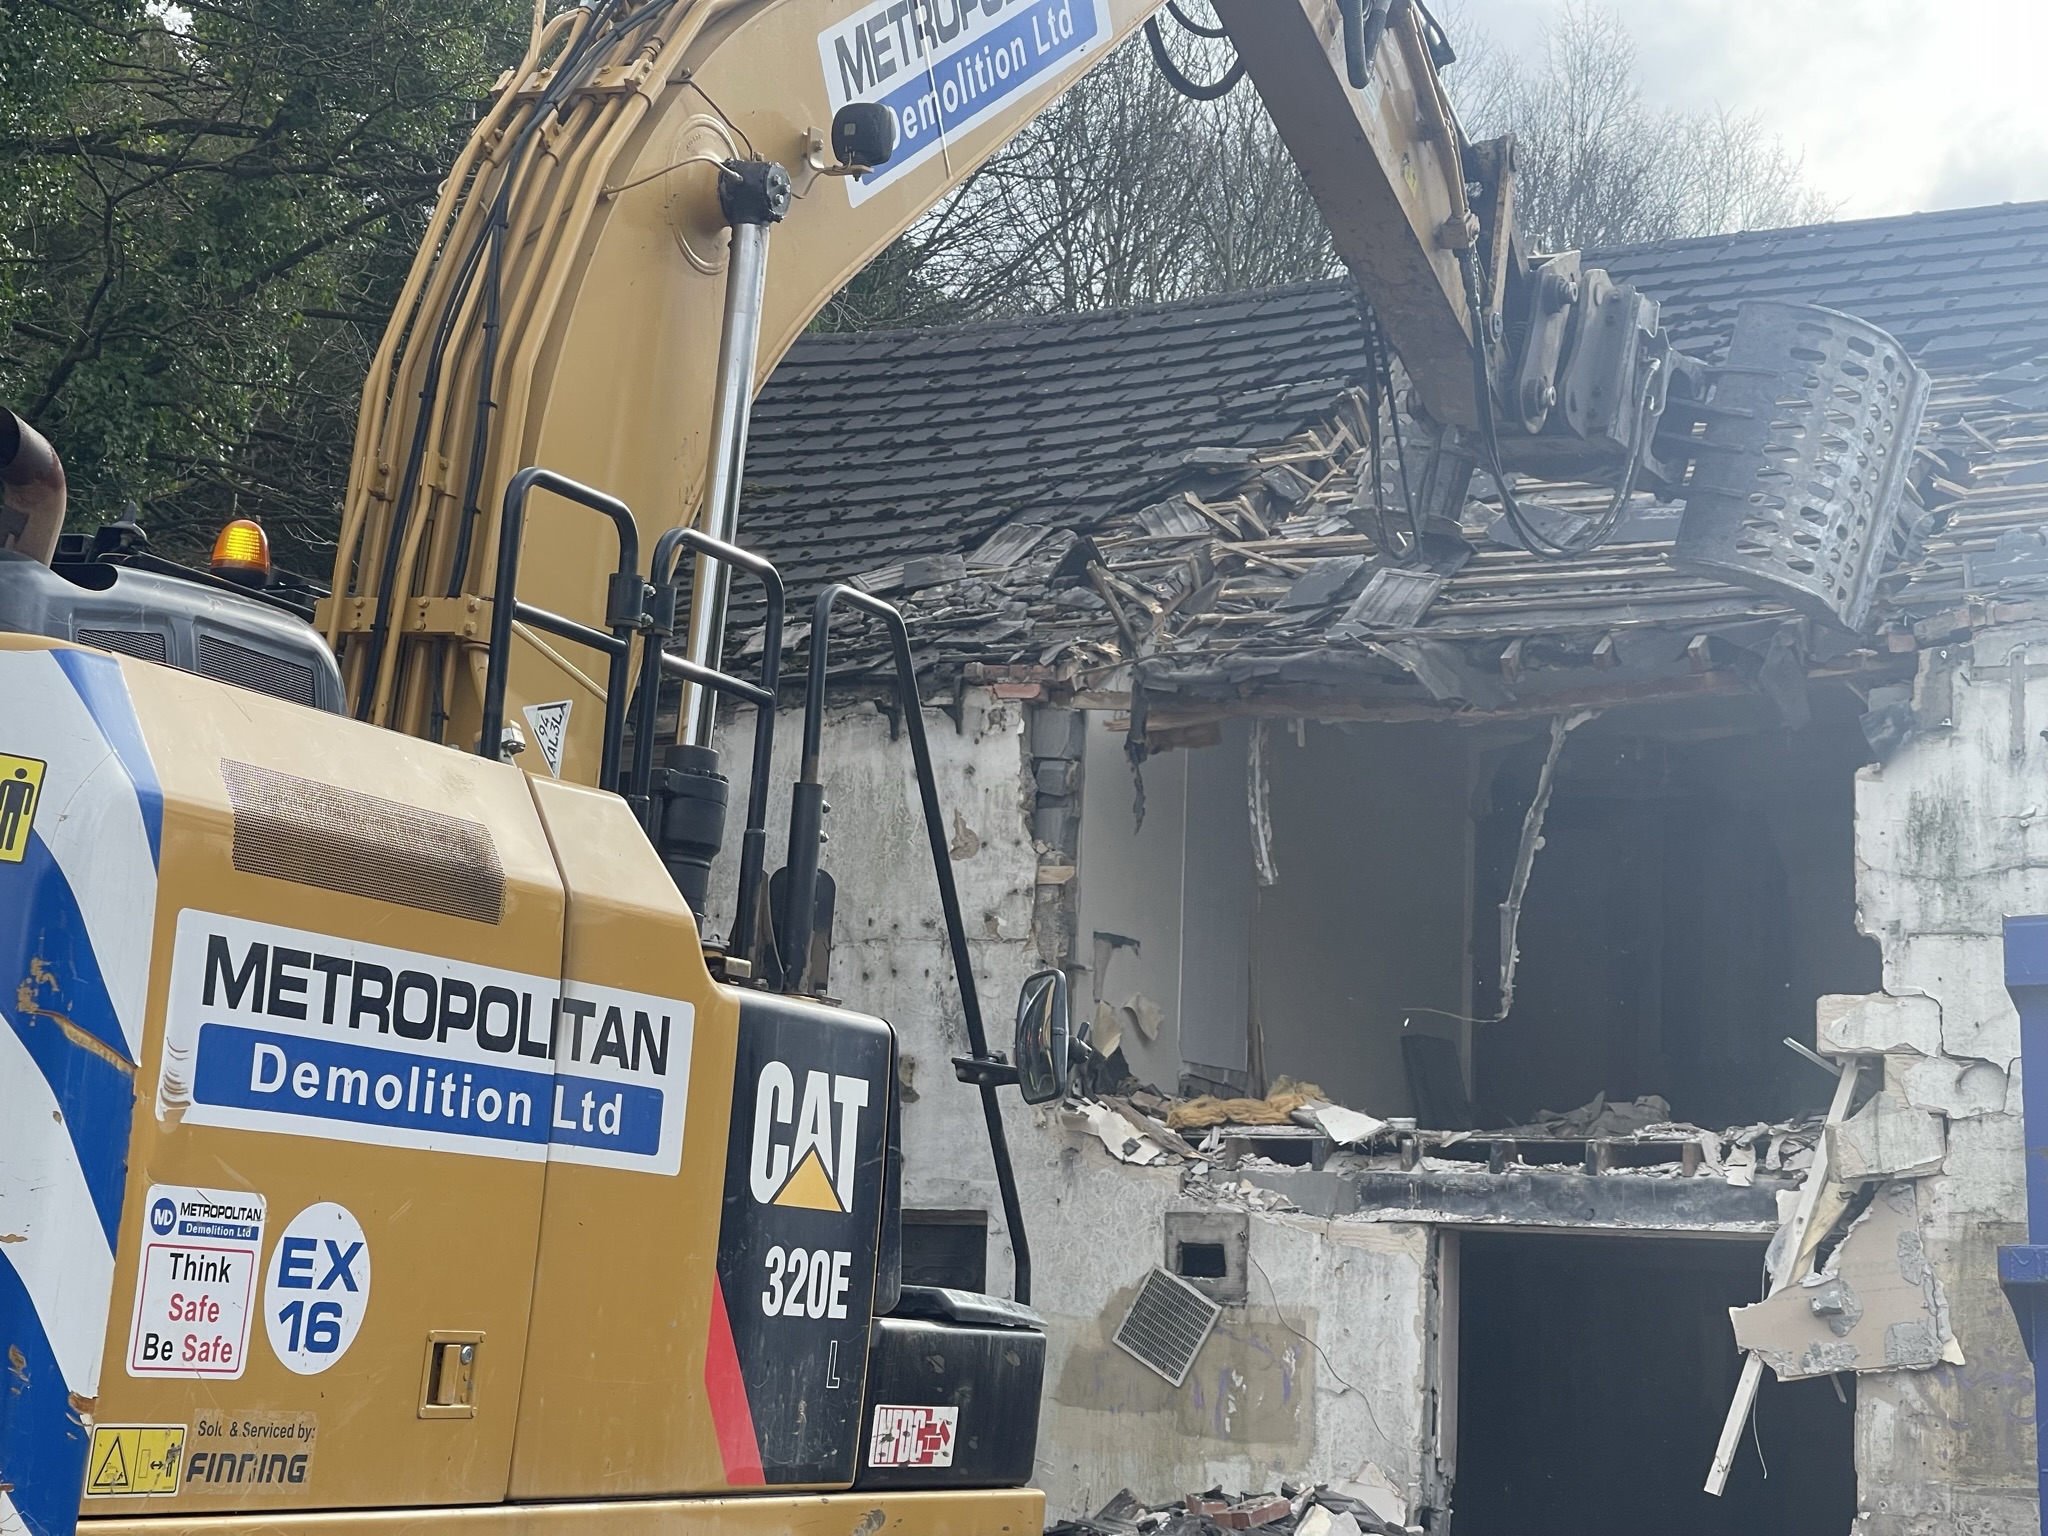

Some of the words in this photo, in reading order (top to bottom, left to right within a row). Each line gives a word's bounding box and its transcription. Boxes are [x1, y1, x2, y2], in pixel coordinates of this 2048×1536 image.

[889, 36, 1028, 150] emolition
[1032, 0, 1074, 56] Ltd
[538, 715, 550, 737] 94
[202, 934, 671, 1077] METROPOLITAN
[250, 1042, 532, 1127] Demolition
[553, 1085, 623, 1136] Ltd
[750, 1061, 869, 1213] CAT
[154, 1208, 174, 1227] MD
[180, 1202, 262, 1221] METROPOLITAN
[186, 1223, 234, 1237] Demolition
[237, 1228, 252, 1238] Ltd
[169, 1252, 232, 1283] Think
[277, 1236, 364, 1292] EX
[761, 1245, 852, 1320] 320E
[168, 1293, 220, 1323] Safe
[278, 1300, 342, 1354] 16
[143, 1333, 173, 1362] Be
[182, 1334, 233, 1363] Safe
[229, 1421, 238, 1437] &
[242, 1421, 295, 1439] Serviced
[297, 1421, 316, 1443] by:
[874, 1408, 927, 1464] NFDC
[185, 1452, 308, 1484] FINNING
